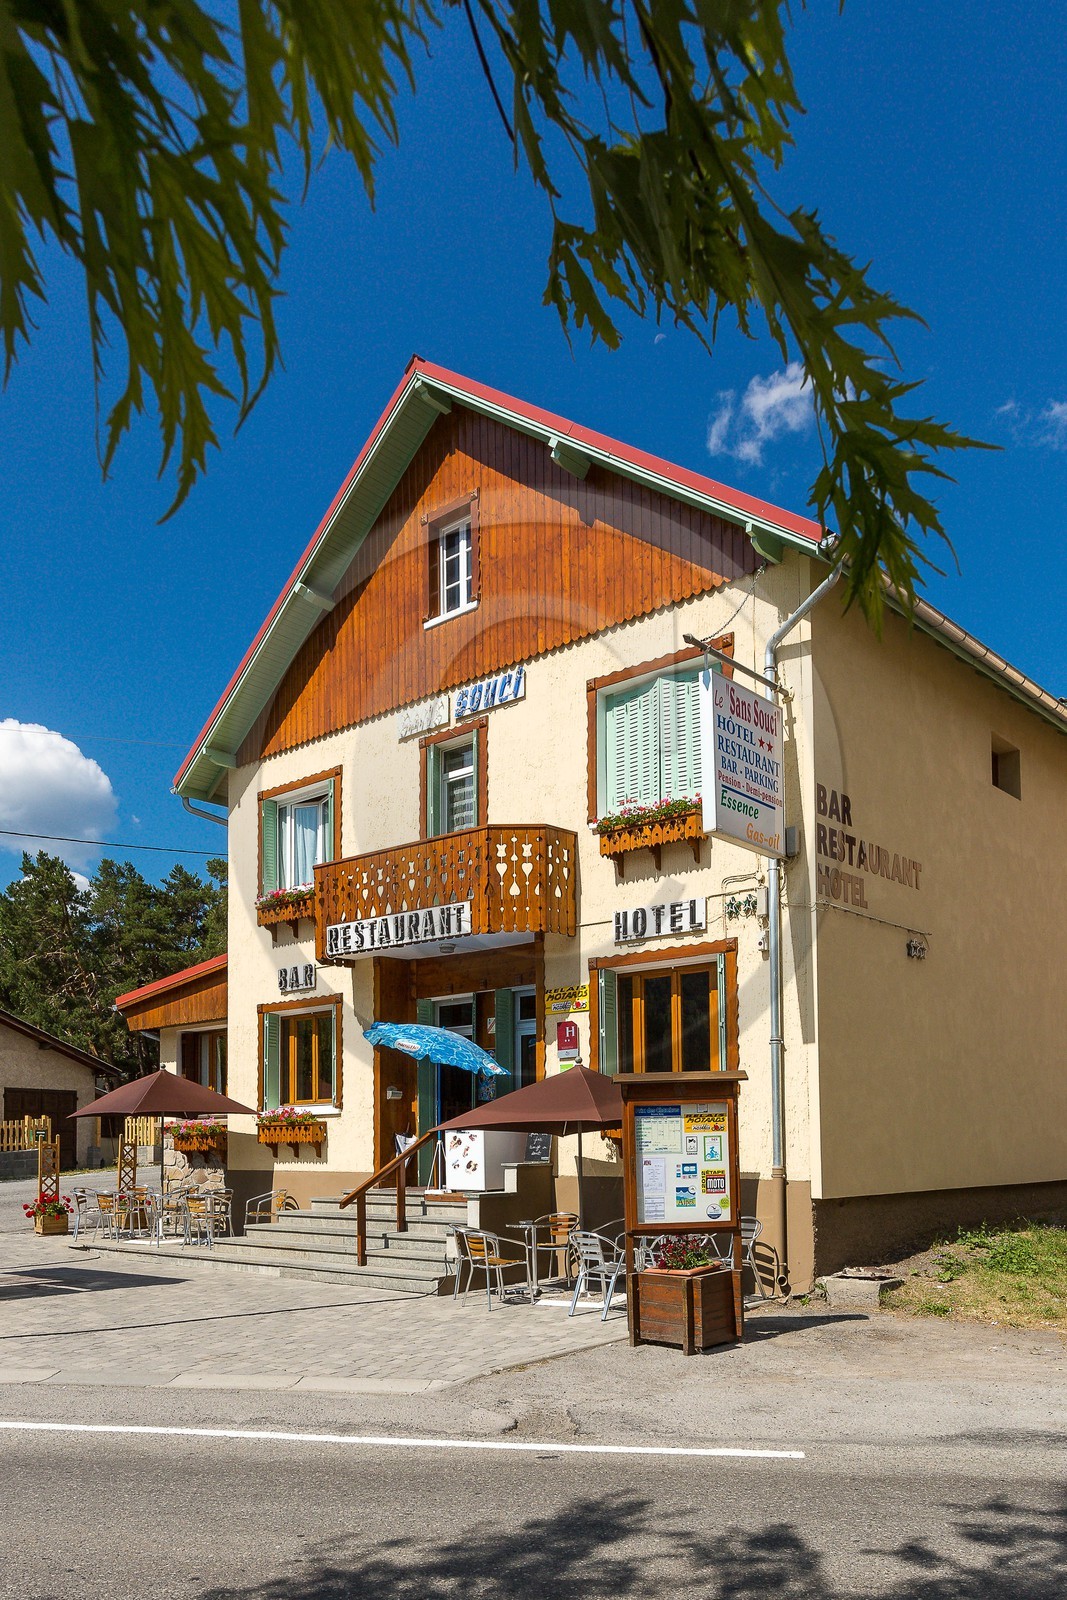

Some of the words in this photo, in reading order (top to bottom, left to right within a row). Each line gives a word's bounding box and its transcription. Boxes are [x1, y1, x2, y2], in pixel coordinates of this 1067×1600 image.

[714, 690, 724, 708] Le
[716, 714, 756, 746] HÔTEL
[717, 734, 780, 778] RESTAURANT
[718, 769, 741, 789] Pension
[745, 782, 783, 807] Demi-pension
[721, 755, 738, 775] BAR
[744, 766, 779, 793] PARKING
[720, 789, 759, 819] Essence
[816, 782, 852, 827] BAR
[746, 822, 780, 850] Gas-oil
[816, 822, 922, 890] RESTAURANT
[816, 862, 868, 909] HOTEL
[327, 904, 465, 954] RESTAURANT
[614, 899, 703, 940] HOTEL
[278, 964, 314, 989] BAR
[545, 984, 587, 995] RELAIS
[546, 990, 588, 1002] MOTARDS
[565, 1025, 575, 1038] H
[706, 1178, 725, 1189] MOTO
